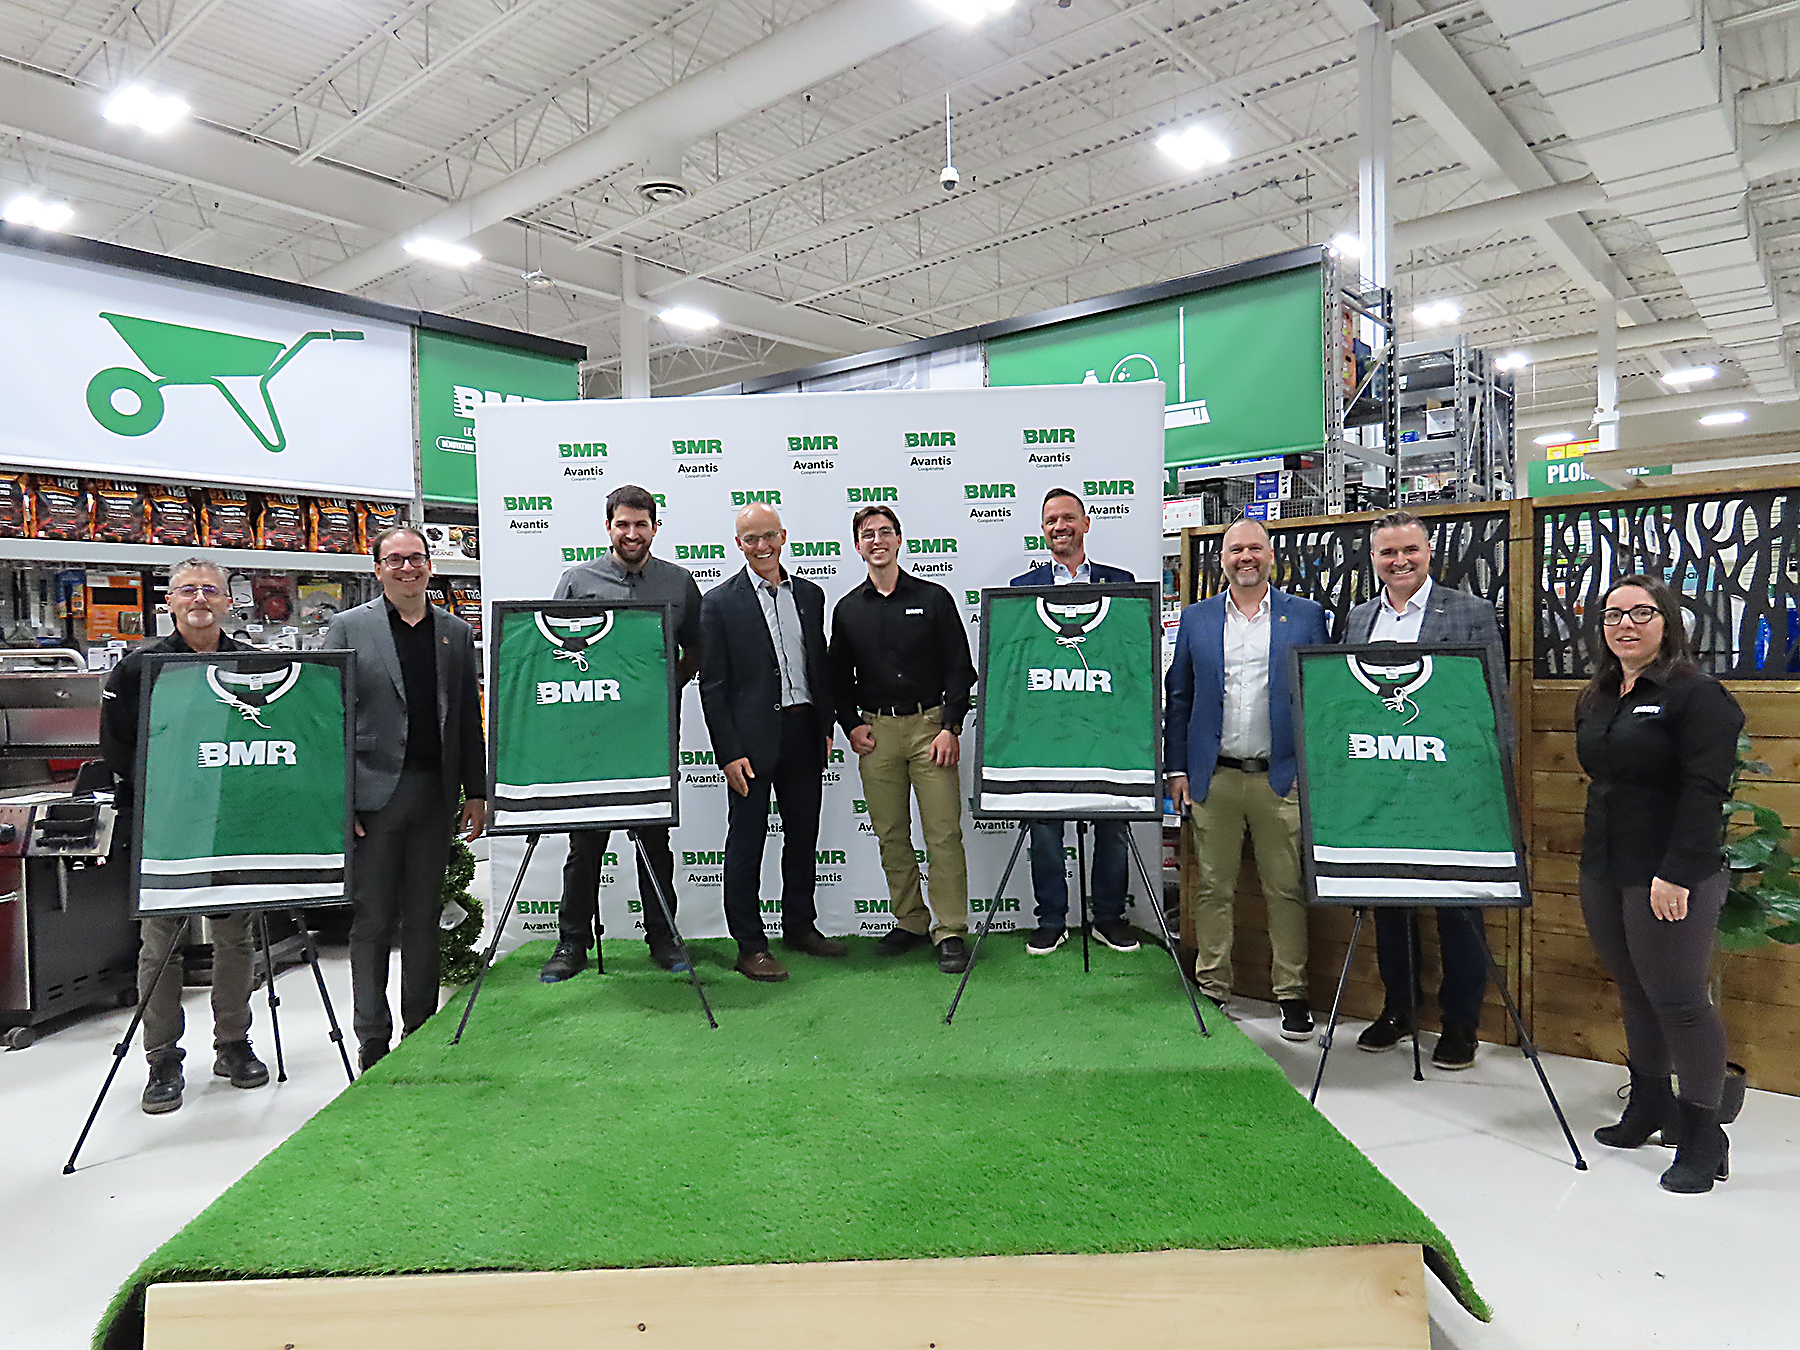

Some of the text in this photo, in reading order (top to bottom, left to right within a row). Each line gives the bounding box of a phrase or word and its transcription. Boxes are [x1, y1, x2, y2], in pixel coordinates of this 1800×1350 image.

[905, 432, 956, 447] BMR
[1023, 428, 1075, 444] BMR
[558, 443, 607, 458] BMR
[672, 440, 722, 455] BMR
[787, 436, 838, 451] BMR
[793, 459, 834, 470] Avantis
[910, 456, 952, 467] Avantis
[1028, 452, 1071, 463] Avantis
[563, 466, 604, 477] Avantis
[678, 463, 719, 473] Avantis
[847, 487, 898, 503] BMR
[964, 484, 1016, 499] BMR
[1083, 480, 1135, 496] BMR
[504, 496, 552, 511] BMR
[731, 490, 782, 506] BMR
[970, 507, 1012, 518] Avantis
[1088, 504, 1130, 515] Avantis
[510, 519, 549, 529] Avantis
[675, 545, 726, 560] BMR
[790, 541, 841, 557] BMR
[906, 538, 958, 554] BMR
[690, 568, 722, 578] vantis
[796, 565, 837, 576] Avantis
[912, 562, 954, 573] Avantis
[1027, 669, 1113, 693] BMR
[537, 679, 621, 705] BMR
[198, 740, 297, 767] BMR
[1348, 733, 1447, 762] BMR
[679, 751, 718, 765] BM
[685, 773, 726, 783] Avantis
[973, 821, 1015, 830] Avantis
[815, 851, 847, 864] MR
[688, 873, 724, 883] Avanti
[815, 872, 842, 882] antis
[854, 900, 893, 914] BM
[523, 921, 560, 930] Avanti
[975, 920, 1016, 930] Aantis
